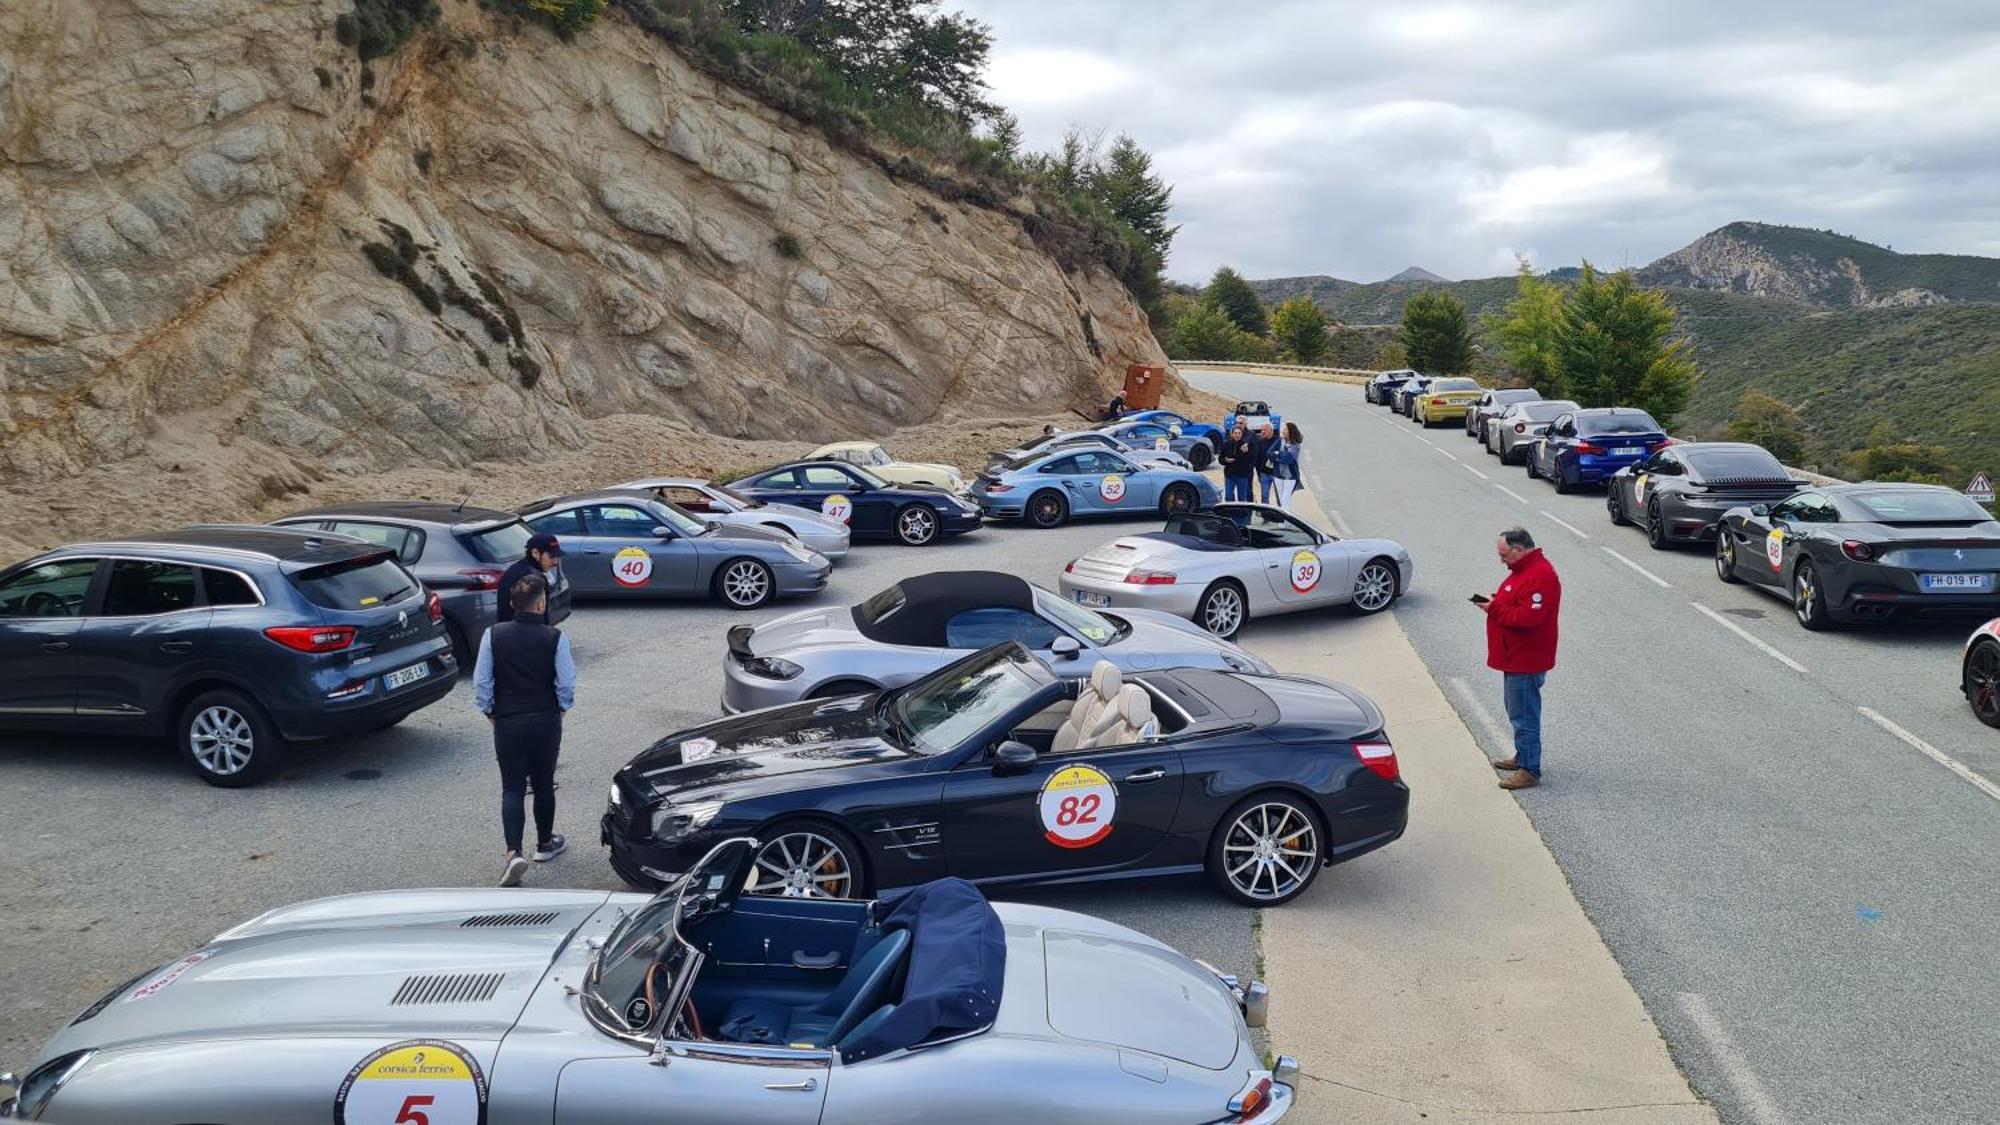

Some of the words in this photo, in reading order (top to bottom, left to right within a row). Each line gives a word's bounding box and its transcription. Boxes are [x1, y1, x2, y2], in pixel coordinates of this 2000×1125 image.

[1105, 484, 1120, 494] 52
[829, 506, 845, 517] 47
[621, 561, 643, 575] 40
[1297, 565, 1314, 581] 39
[1931, 575, 1980, 585] FH-019-YF
[1056, 794, 1101, 826] 82
[378, 1063, 417, 1073] corsica
[419, 1064, 455, 1073] ferries
[394, 1095, 435, 1125] 5
